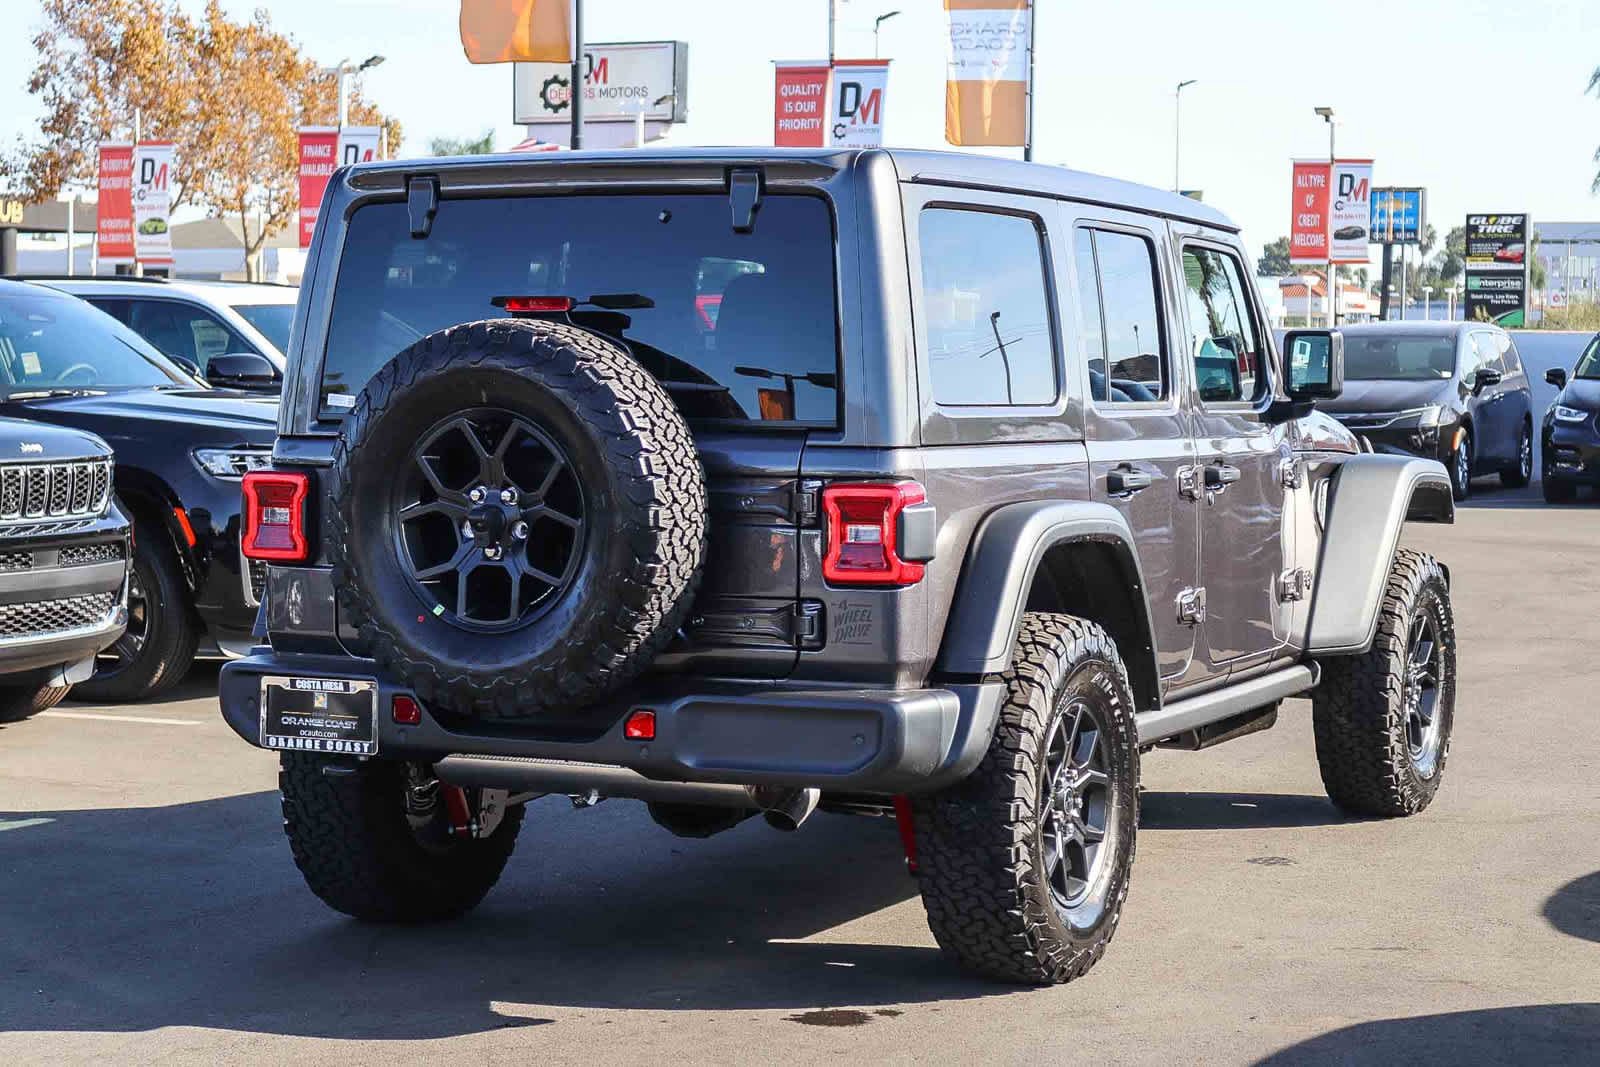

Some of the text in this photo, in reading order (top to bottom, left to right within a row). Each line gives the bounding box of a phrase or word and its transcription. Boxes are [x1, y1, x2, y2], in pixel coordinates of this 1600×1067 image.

[599, 86, 649, 99] MOTORS
[781, 84, 823, 96] QUALITY
[785, 101, 816, 112] IS OUR
[839, 82, 882, 125] DM
[779, 119, 822, 130] PRIORITY
[303, 145, 332, 157] FINANCE
[141, 158, 168, 191] DM
[300, 163, 334, 176] AVAILABLE
[1297, 174, 1325, 188] ALL TYPE
[1339, 173, 1369, 202] DM
[1305, 194, 1314, 208] OF
[1298, 214, 1320, 228] CREDIT
[1469, 215, 1524, 225] GLOBE
[1478, 225, 1514, 233] TIRE
[1294, 233, 1325, 247] WELCOME
[1471, 279, 1522, 289] enterprise
[833, 607, 872, 628] WHEEL
[834, 623, 872, 643] DRIVE
[295, 679, 345, 692] COSTA MESA
[281, 716, 358, 730] ORANGE COAST
[299, 729, 338, 738] ocauto.com
[268, 736, 369, 753] ORANGE COAST
